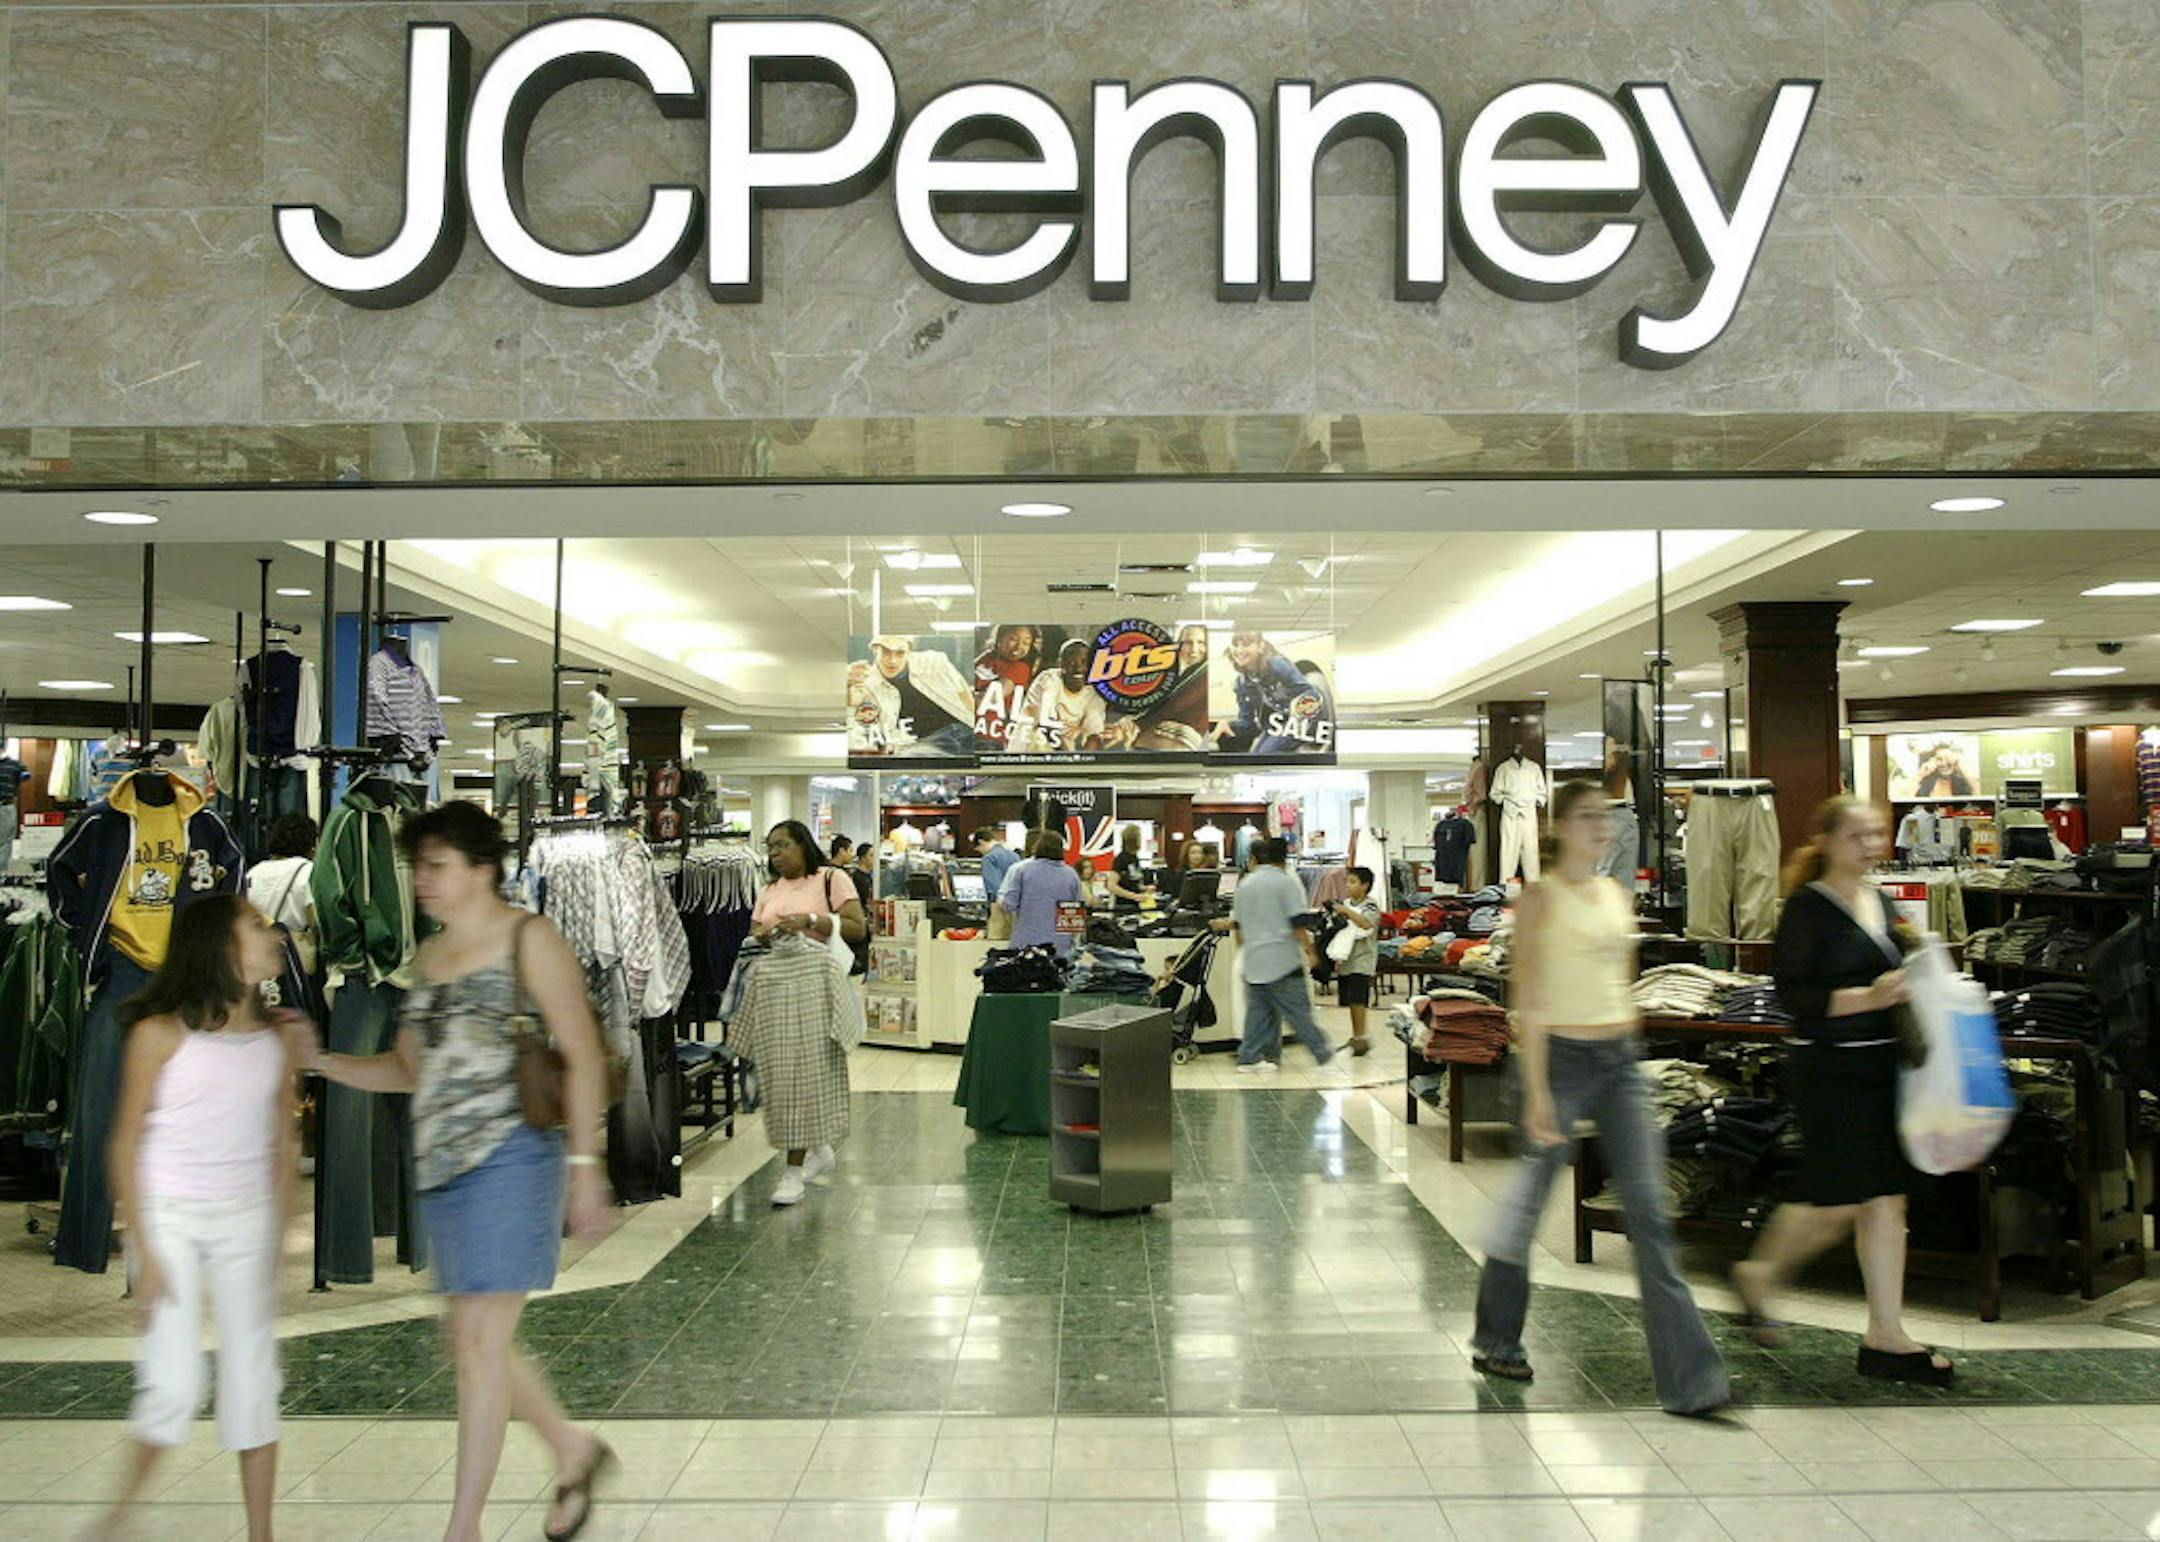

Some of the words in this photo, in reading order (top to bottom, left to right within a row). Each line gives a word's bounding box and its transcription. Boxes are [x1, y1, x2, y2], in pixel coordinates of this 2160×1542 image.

[272, 18, 1821, 369] JCPenney
[1098, 626, 1119, 645] ALL
[1121, 619, 1167, 643] ACCESS
[1087, 643, 1180, 683] bts
[976, 680, 1066, 729] ALL
[974, 716, 1062, 748] ACCESS
[1267, 713, 1334, 744] SALE
[1996, 749, 2056, 769] shirts
